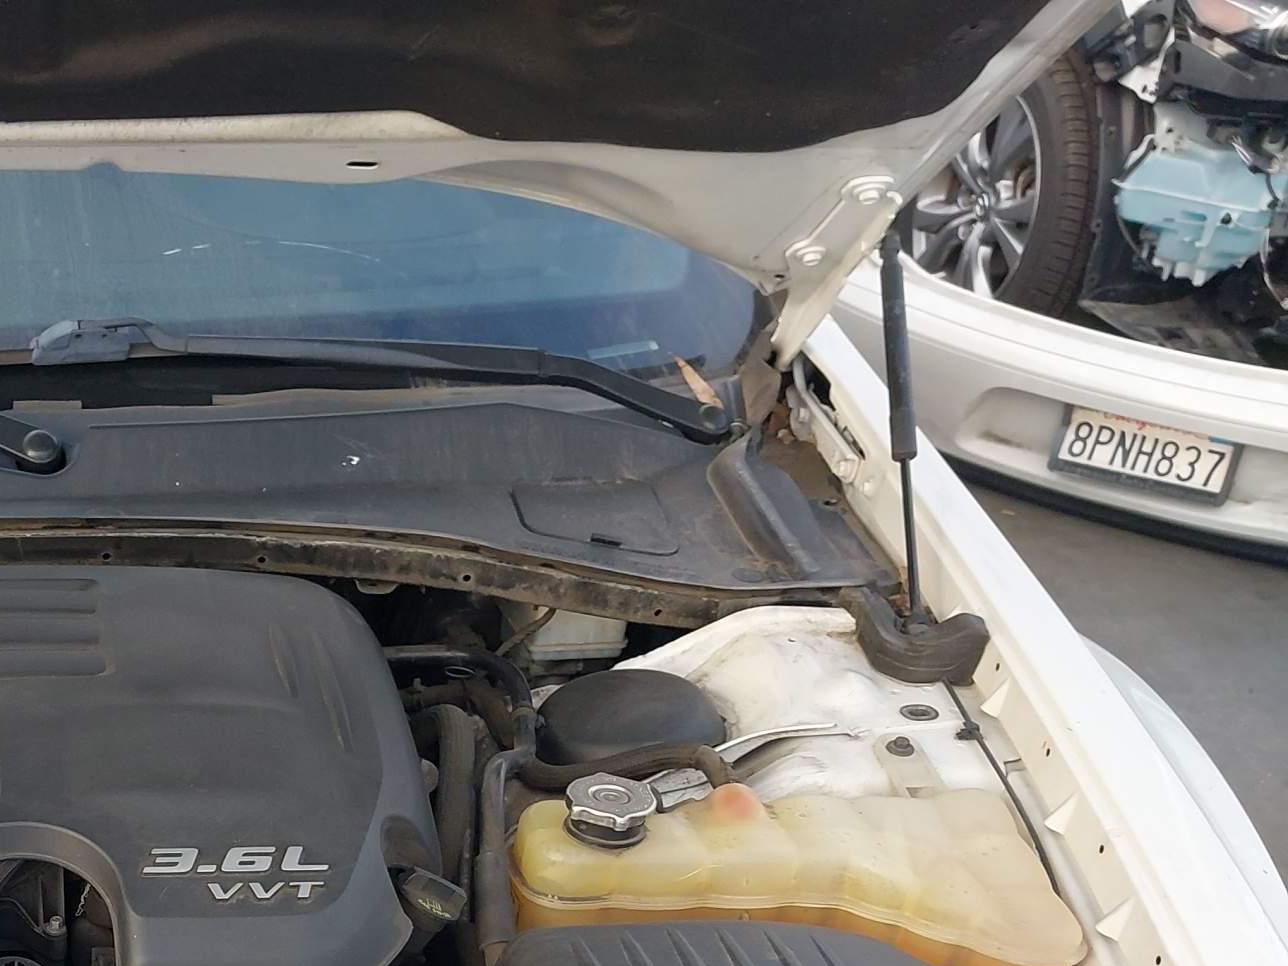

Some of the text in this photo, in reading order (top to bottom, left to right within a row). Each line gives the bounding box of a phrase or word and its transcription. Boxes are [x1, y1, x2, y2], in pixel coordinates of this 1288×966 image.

[1067, 421, 1226, 487] 8PNH837
[142, 846, 329, 873] 3.6L
[207, 881, 325, 899] VVT
